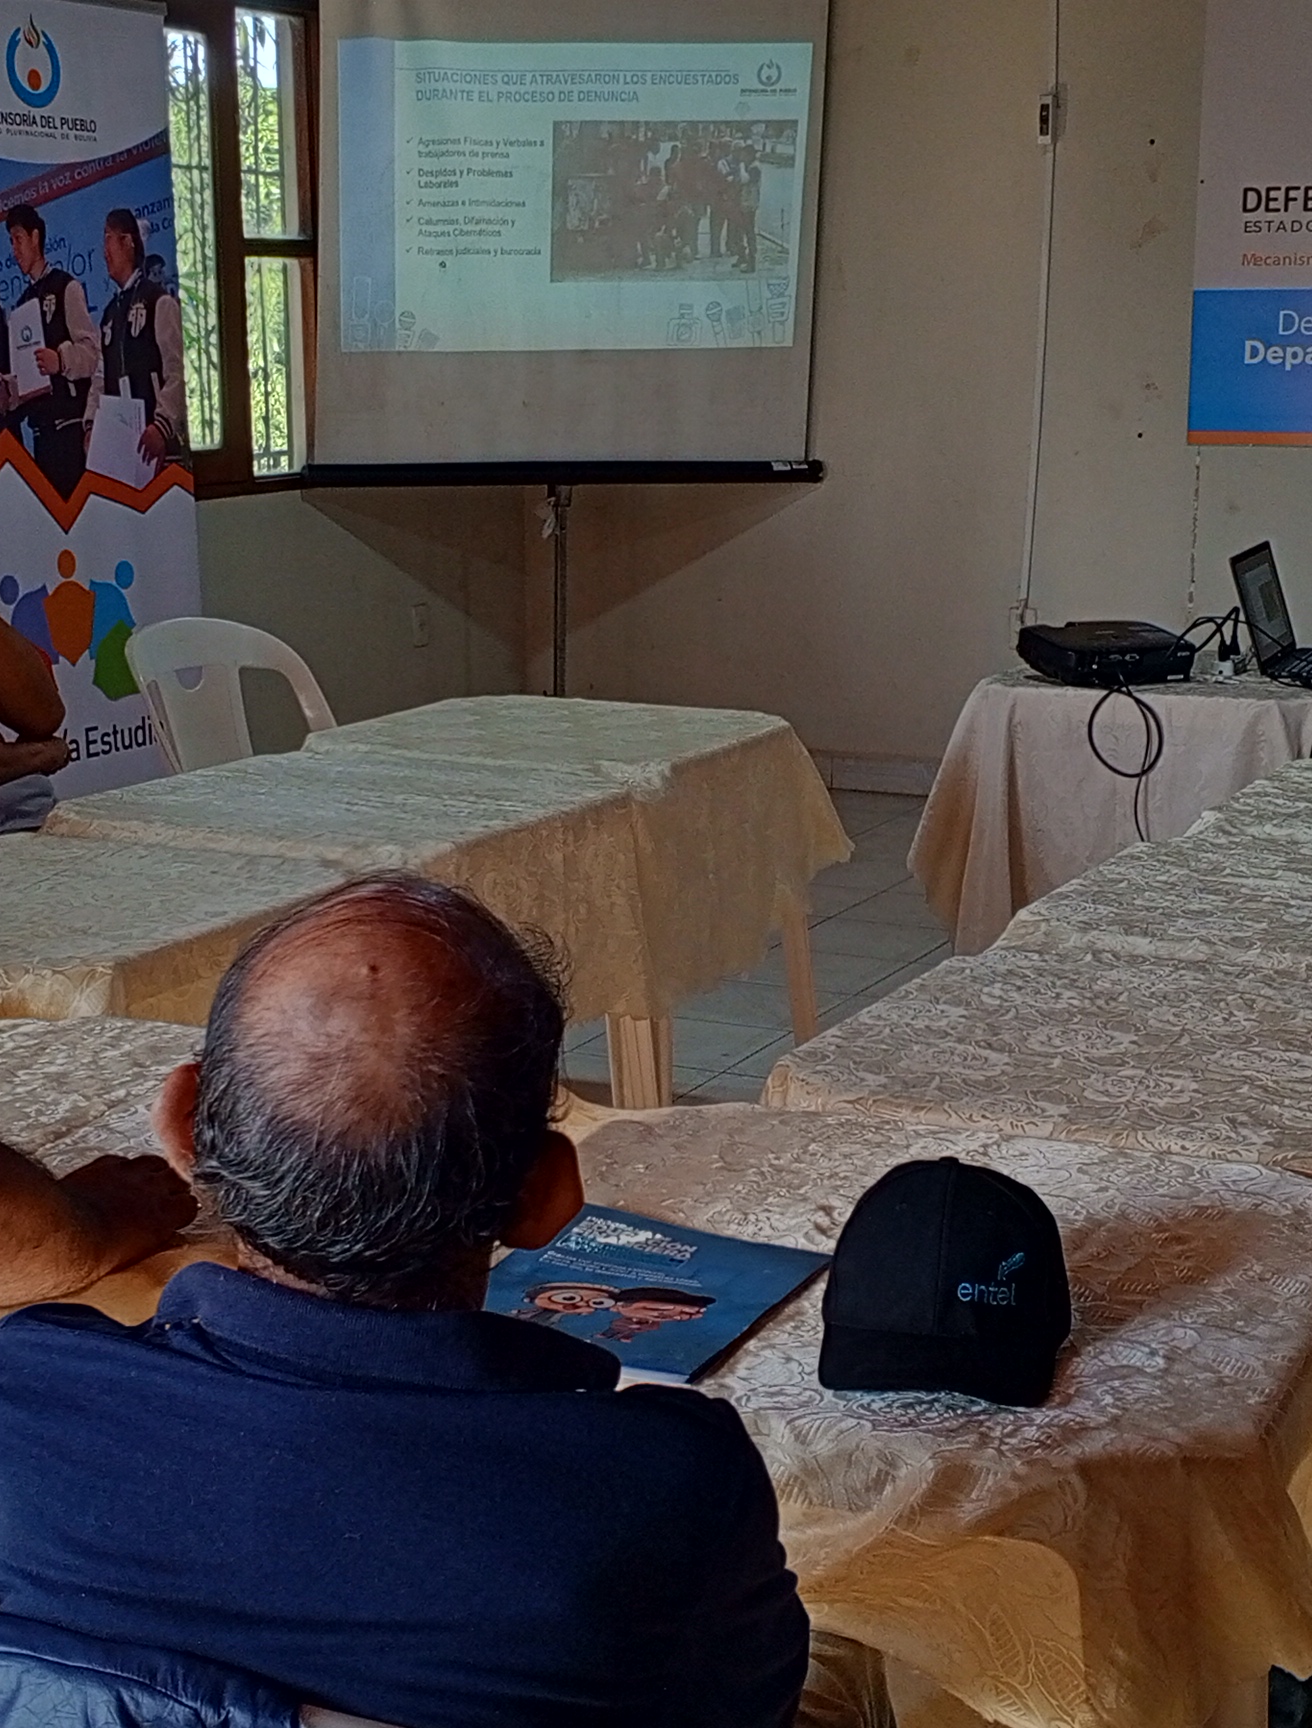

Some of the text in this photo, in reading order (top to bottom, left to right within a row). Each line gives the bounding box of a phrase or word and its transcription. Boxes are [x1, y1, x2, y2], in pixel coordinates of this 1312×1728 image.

[415, 71, 739, 86] SITUACIONES QUE ATRAVESARON LOS ENCUESTADOS
[415, 89, 639, 103] DURANTE EL PROCESO DE DENUNCIA
[40, 115, 58, 130] DEL
[60, 117, 97, 133] PUEBLO
[469, 150, 479, 158] de
[482, 151, 510, 160] prensa
[417, 168, 457, 179] Despidos
[466, 168, 513, 178] Problemas
[50, 172, 72, 192] voz
[418, 180, 459, 189] Laborales
[85, 715, 157, 758] Estudi
[957, 1282, 1016, 1306] entel
